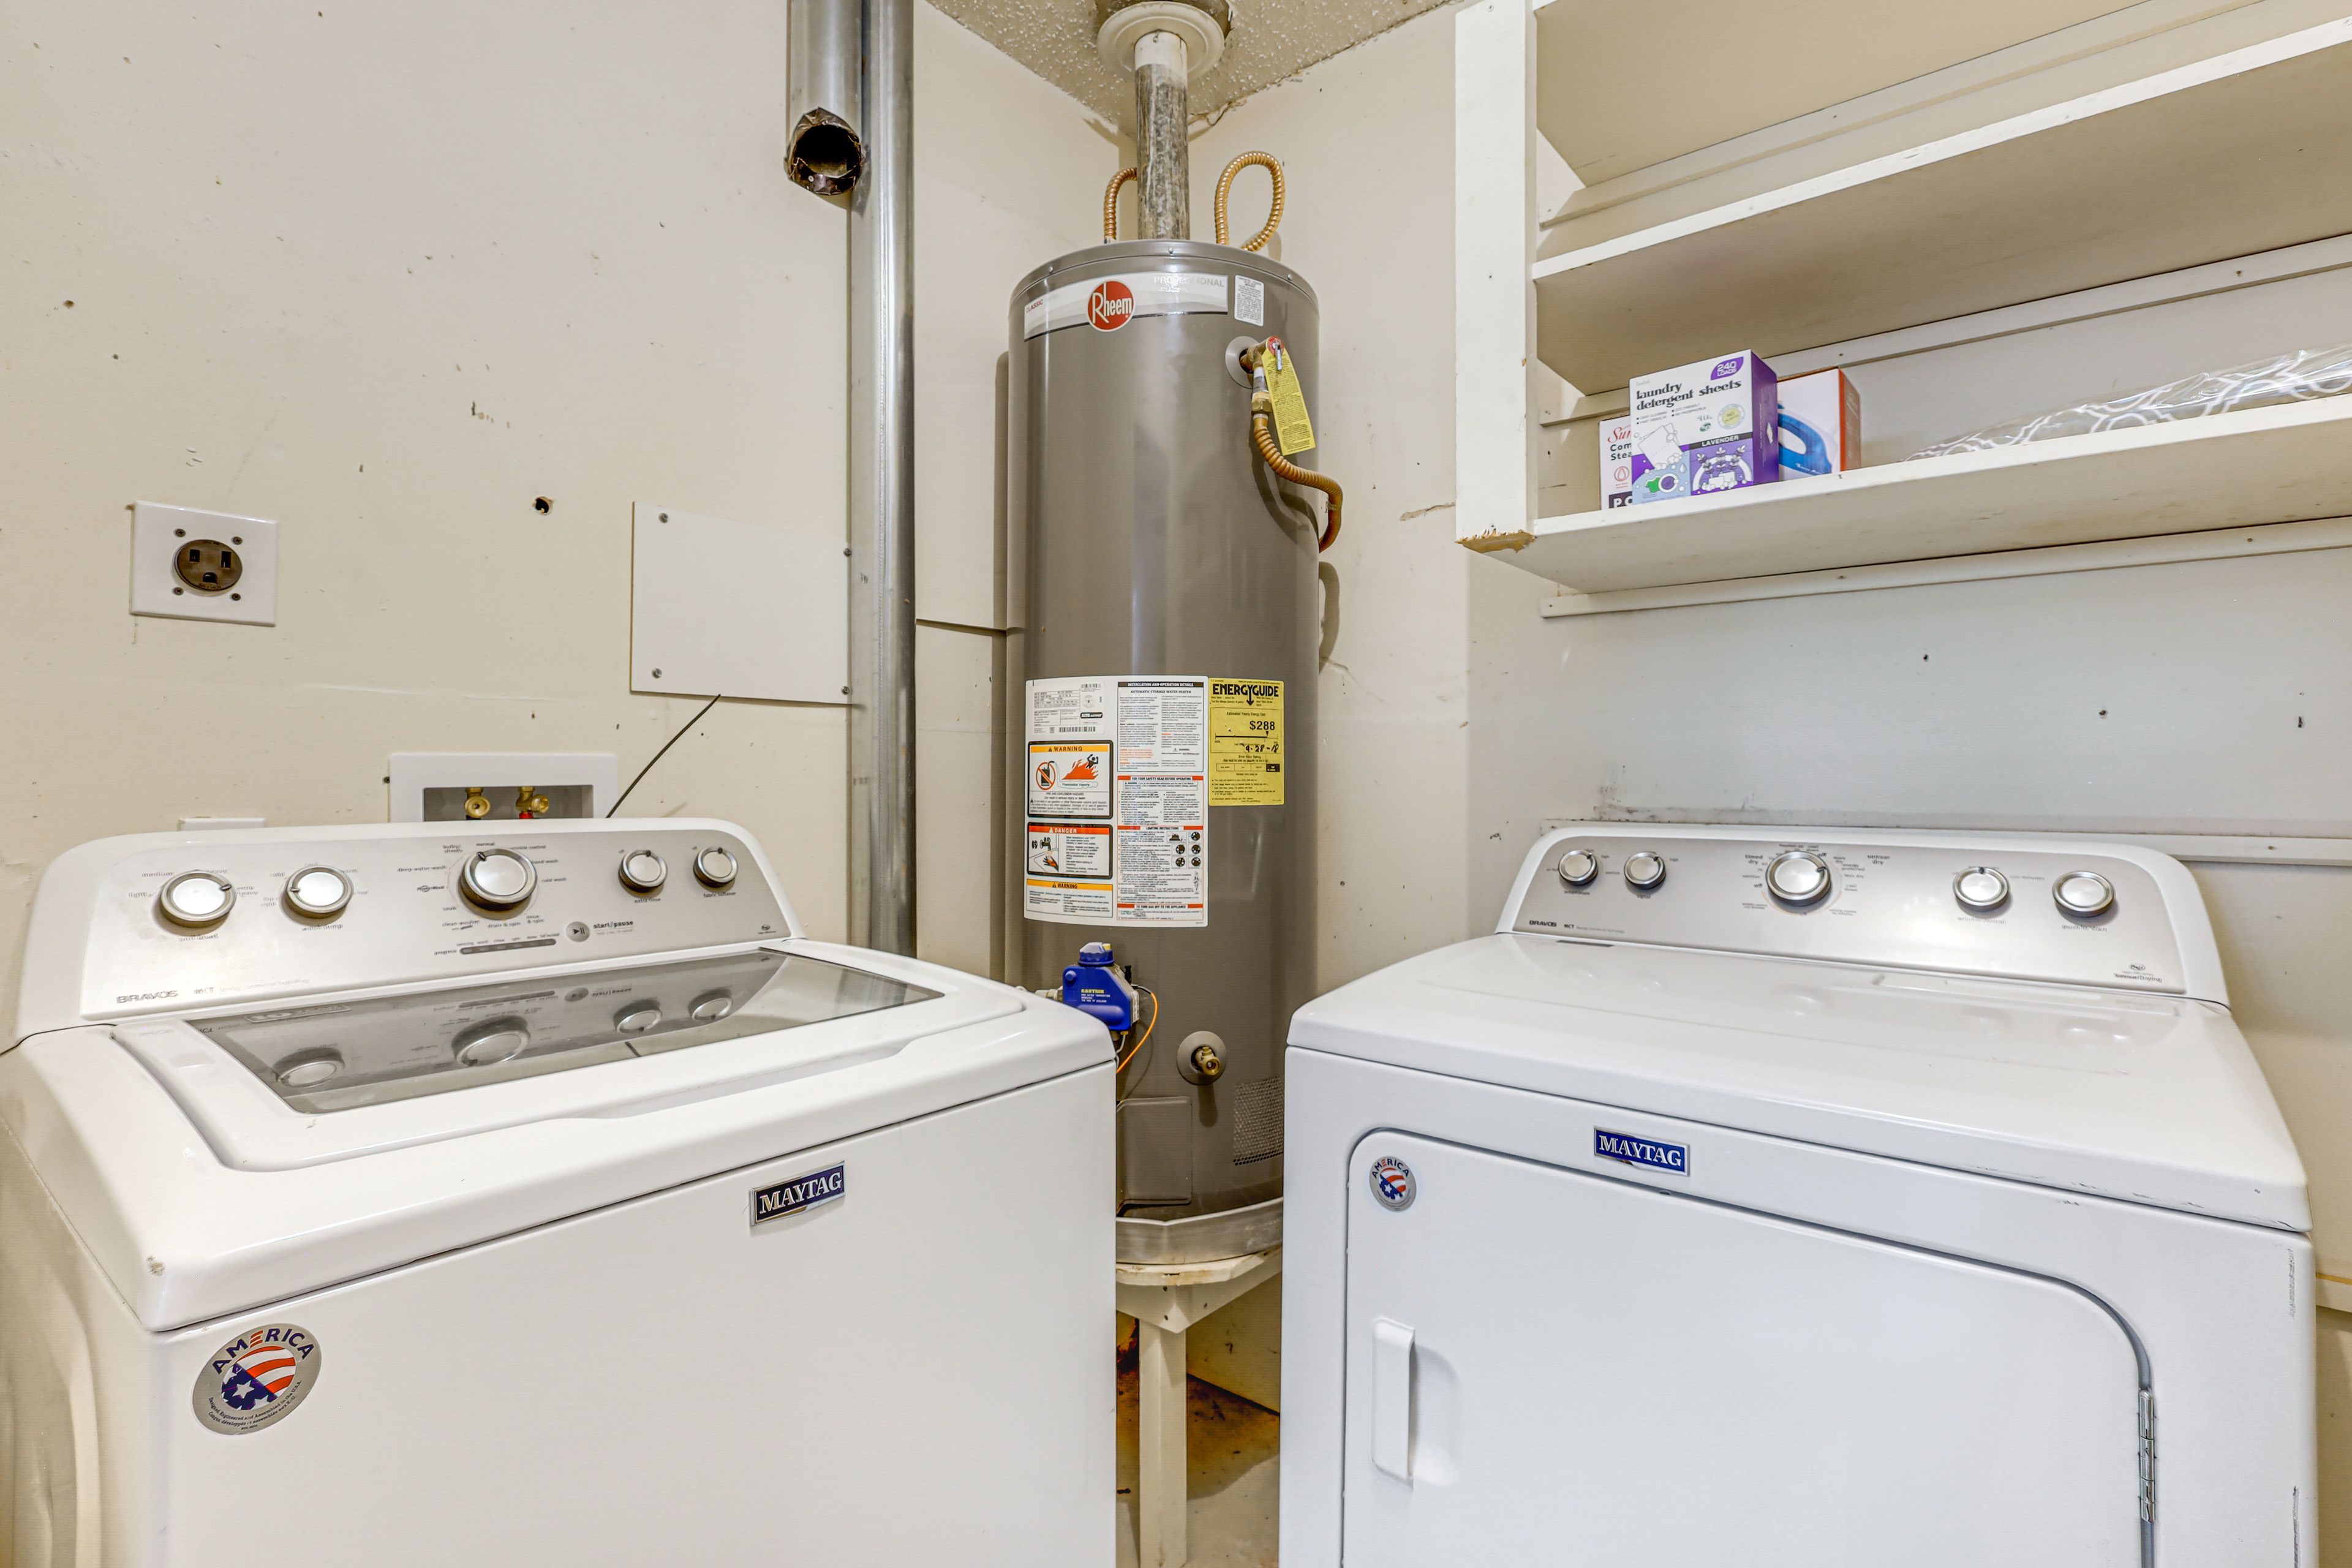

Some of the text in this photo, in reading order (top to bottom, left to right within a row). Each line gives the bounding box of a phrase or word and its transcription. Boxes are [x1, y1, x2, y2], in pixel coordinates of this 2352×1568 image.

[1026, 299, 1043, 314] CLASSIC
[1092, 282, 1132, 324] Rheem
[1717, 361, 1737, 372] 240
[1636, 383, 1683, 399] laundry
[1636, 380, 1742, 410] detergent sheets
[1702, 435, 1739, 447] LAVENDER
[1213, 684, 1279, 697] ENERGYGUIDE
[1250, 720, 1275, 731] $288
[593, 921, 634, 929] start/pause
[116, 990, 178, 1003] BRAVOS
[1599, 1135, 1682, 1167] MAYTAG
[1372, 1158, 1409, 1178] AMERICA
[760, 1172, 842, 1214] MAYTAG
[212, 1328, 315, 1374] AMERICA
[255, 1403, 281, 1419] Assembled
